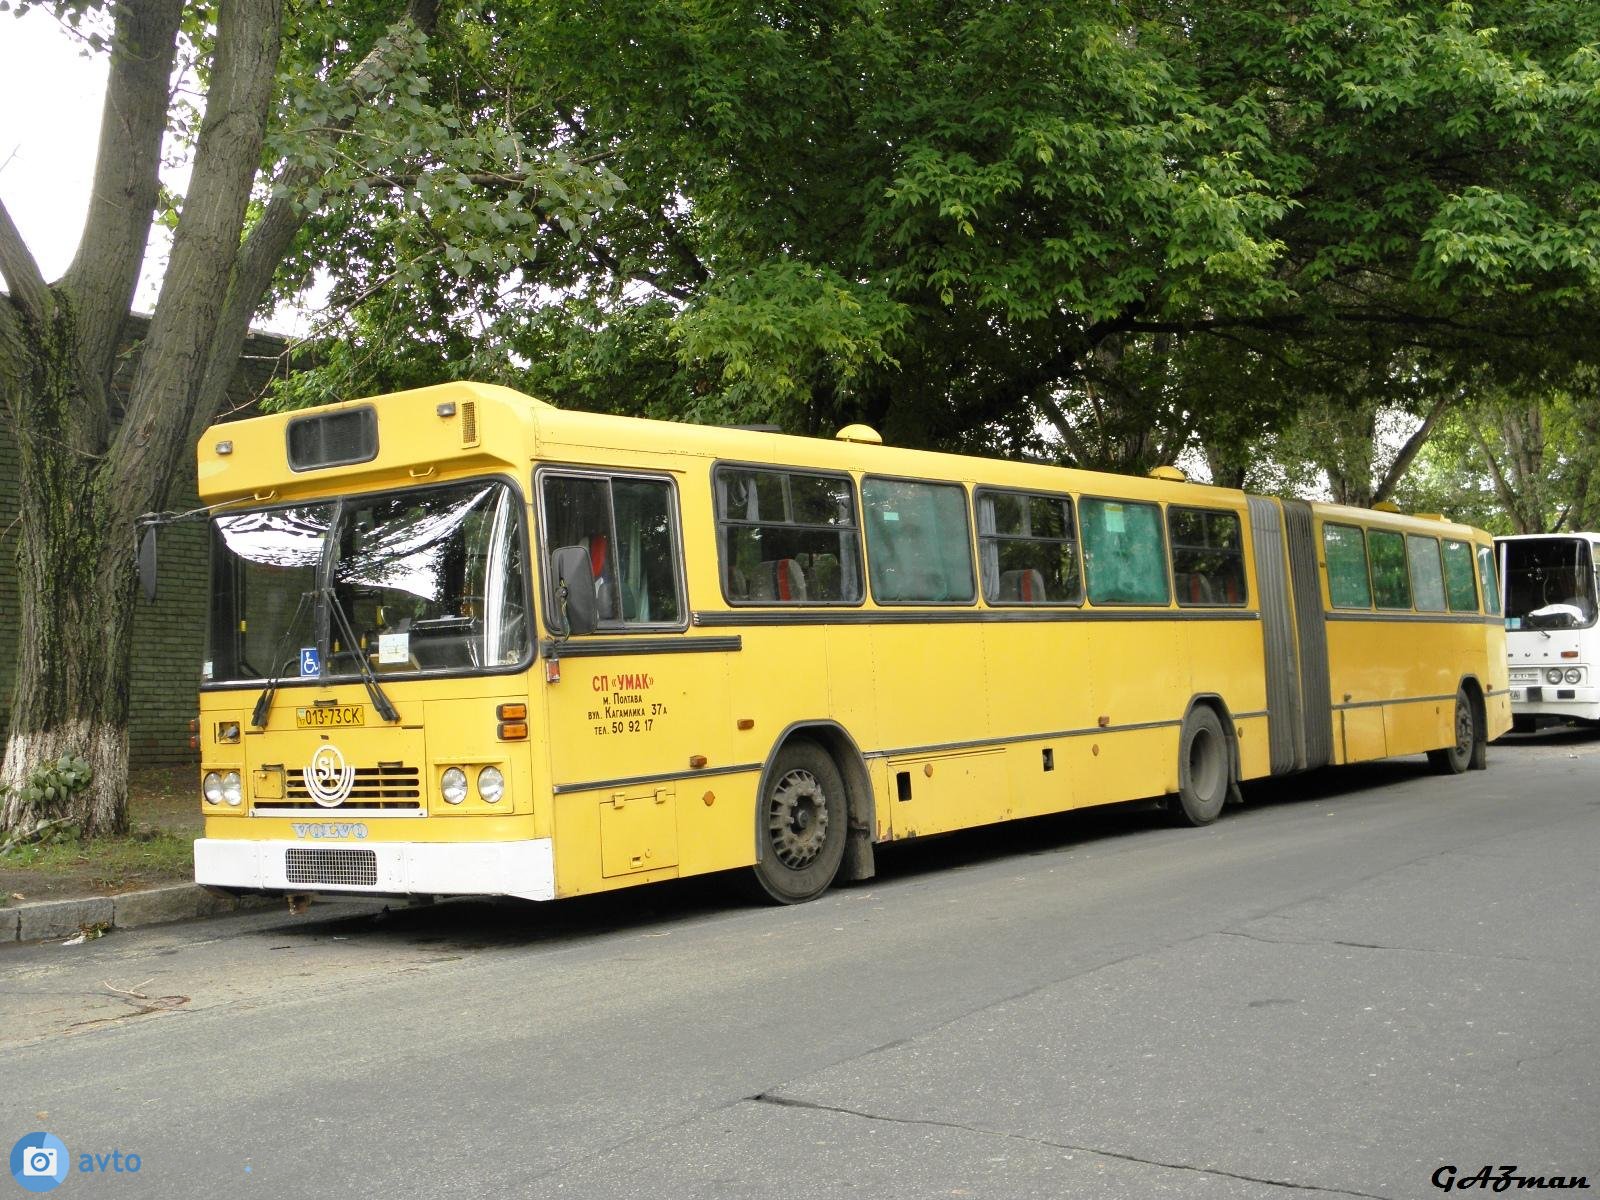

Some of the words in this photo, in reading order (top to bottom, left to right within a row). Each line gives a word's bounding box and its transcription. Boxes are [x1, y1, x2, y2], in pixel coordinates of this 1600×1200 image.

[592, 675, 609, 692] СП
[611, 721, 624, 734] 50
[628, 719, 641, 733] 92
[644, 718, 654, 732] 17
[318, 756, 340, 781] SL
[291, 822, 369, 839] VOLVO
